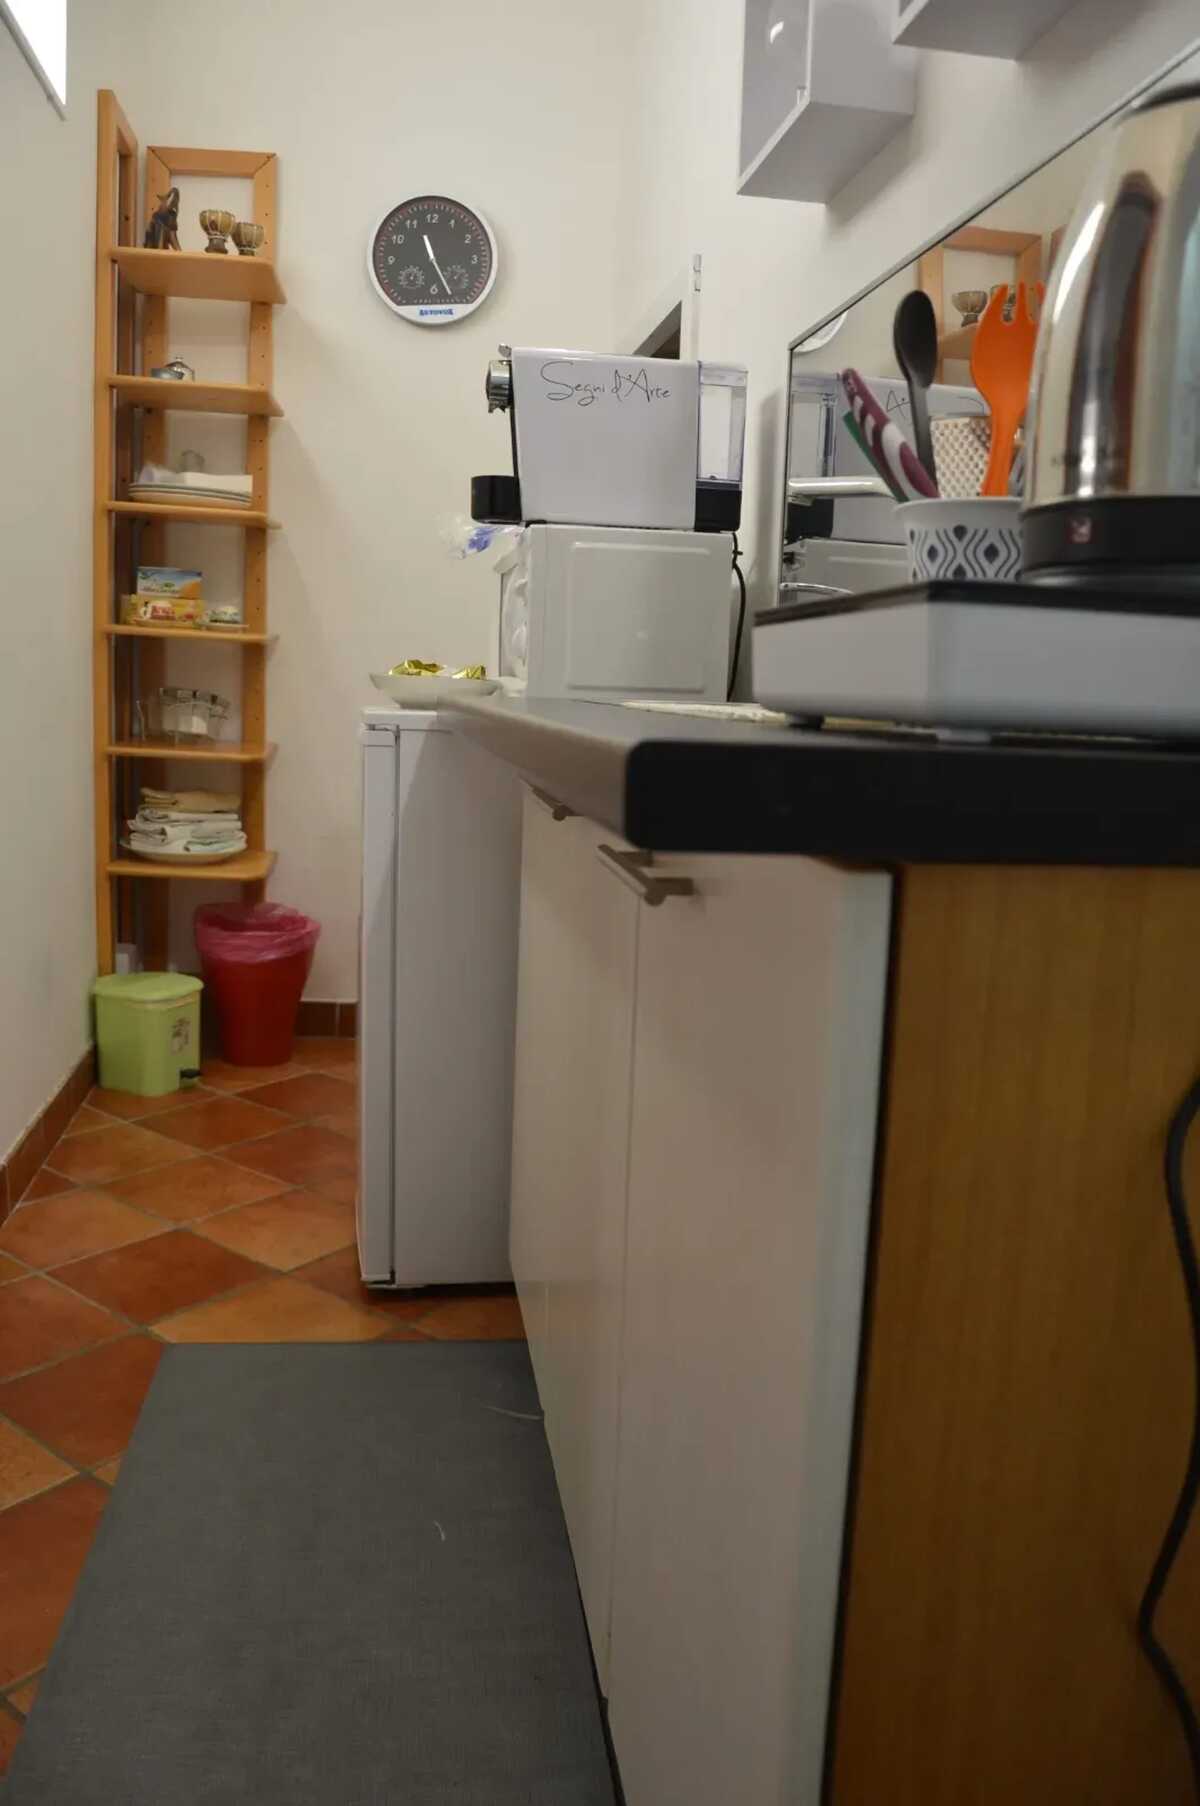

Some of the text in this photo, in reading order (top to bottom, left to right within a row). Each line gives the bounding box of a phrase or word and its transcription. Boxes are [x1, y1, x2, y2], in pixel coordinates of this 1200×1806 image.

[426, 213, 439, 224] 12
[405, 219, 417, 229] 11
[449, 219, 455, 229] 1
[391, 234, 405, 244] 10
[464, 234, 471, 244] 2
[388, 255, 395, 265] 9
[471, 254, 479, 264] 3
[429, 284, 438, 295] 6
[540, 360, 605, 406] Segni
